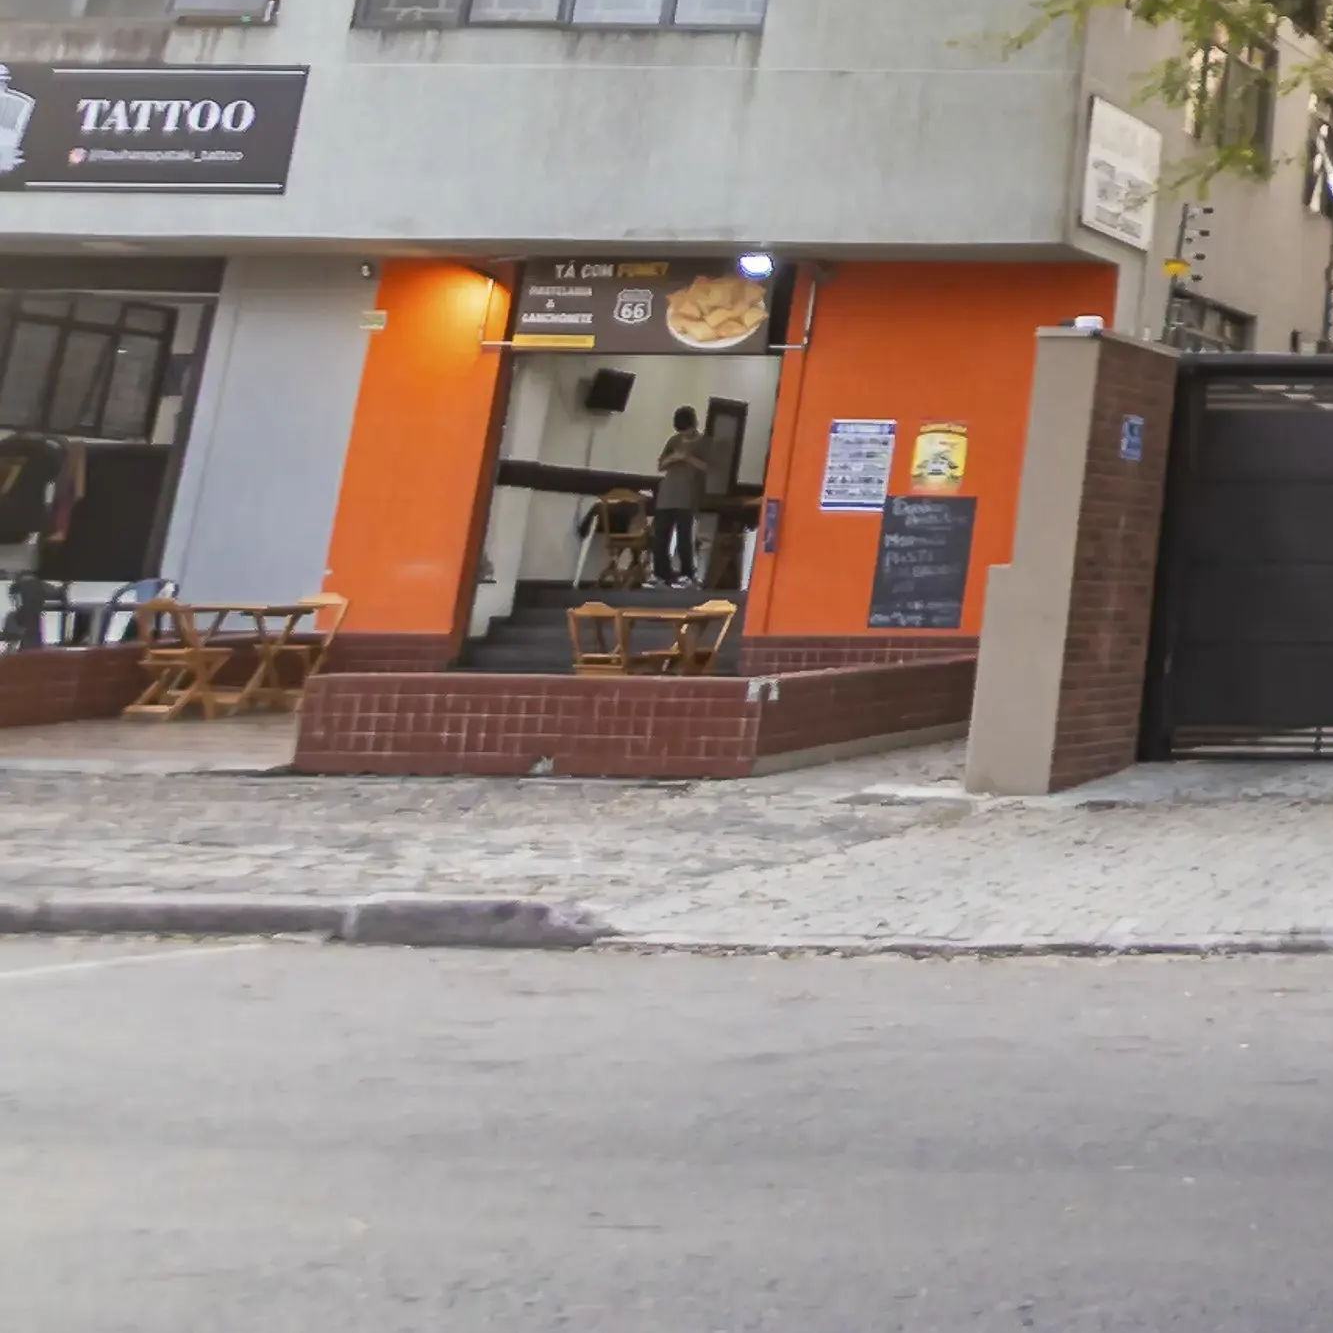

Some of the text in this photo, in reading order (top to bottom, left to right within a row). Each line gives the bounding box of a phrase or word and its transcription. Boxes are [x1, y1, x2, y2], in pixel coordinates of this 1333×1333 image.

[77, 98, 256, 134] TATTOO
[581, 264, 614, 279] COM
[620, 303, 646, 319] 66
